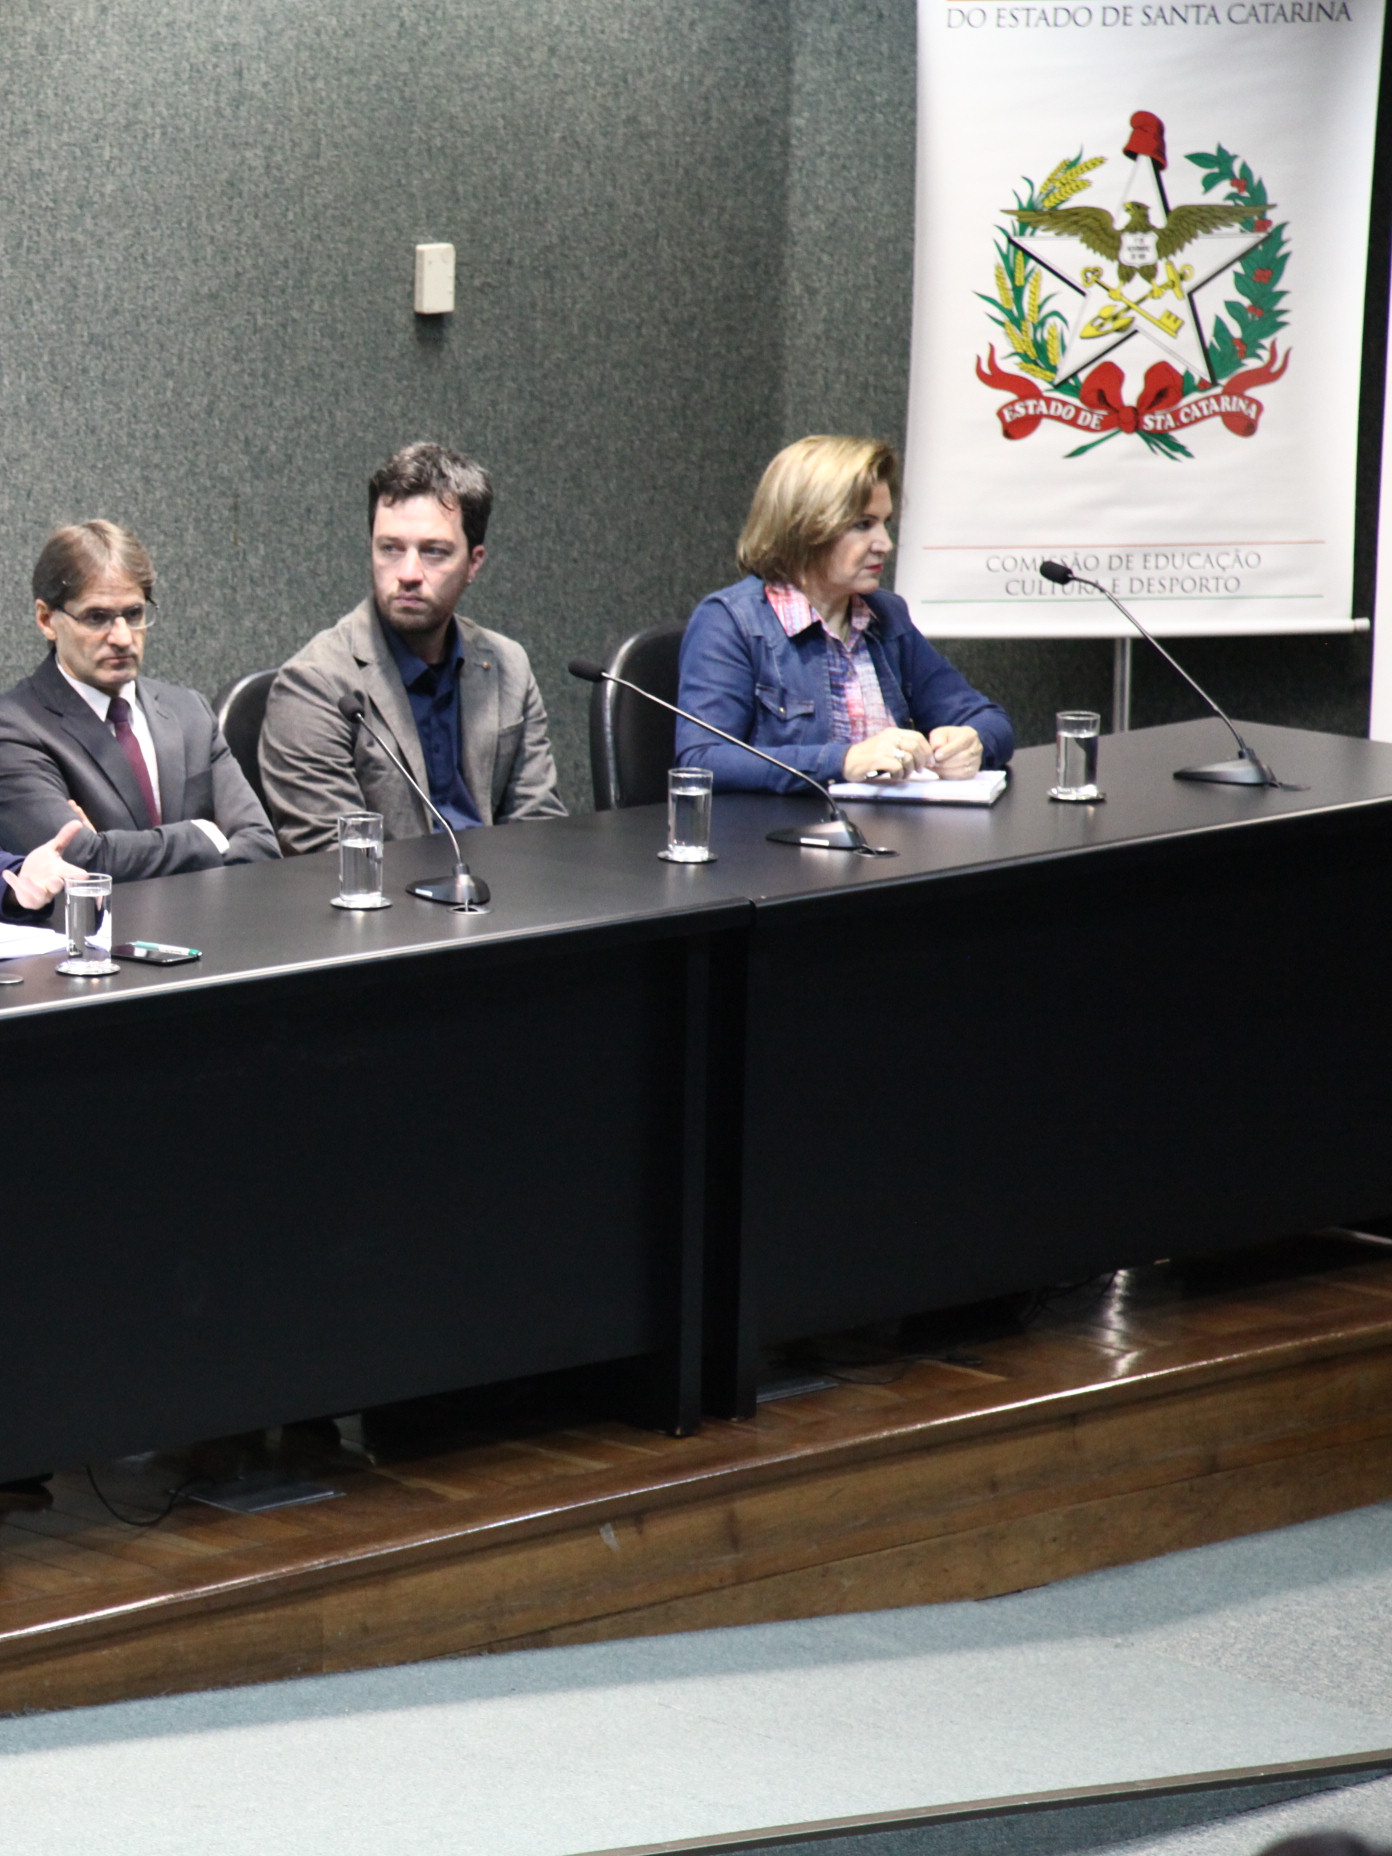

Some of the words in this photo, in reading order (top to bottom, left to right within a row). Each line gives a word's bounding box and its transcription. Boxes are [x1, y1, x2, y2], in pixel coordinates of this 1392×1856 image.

[946, 8, 987, 28] DO
[996, 6, 1093, 28] ESTADO
[1101, 6, 1134, 27] DE
[1140, 4, 1221, 26] SANTA
[1226, 1, 1352, 25] CATARINA
[1002, 399, 1076, 423] ESTADO
[1076, 410, 1104, 430] DE
[1142, 412, 1180, 431] STA.
[1179, 395, 1258, 420] CATARINA
[986, 551, 1100, 573] COMSÃO
[1108, 554, 1133, 572] DE
[1142, 549, 1261, 572] EDUCAÇÃO
[1112, 578, 1120, 594] E
[1129, 576, 1240, 595] DESPORTO
